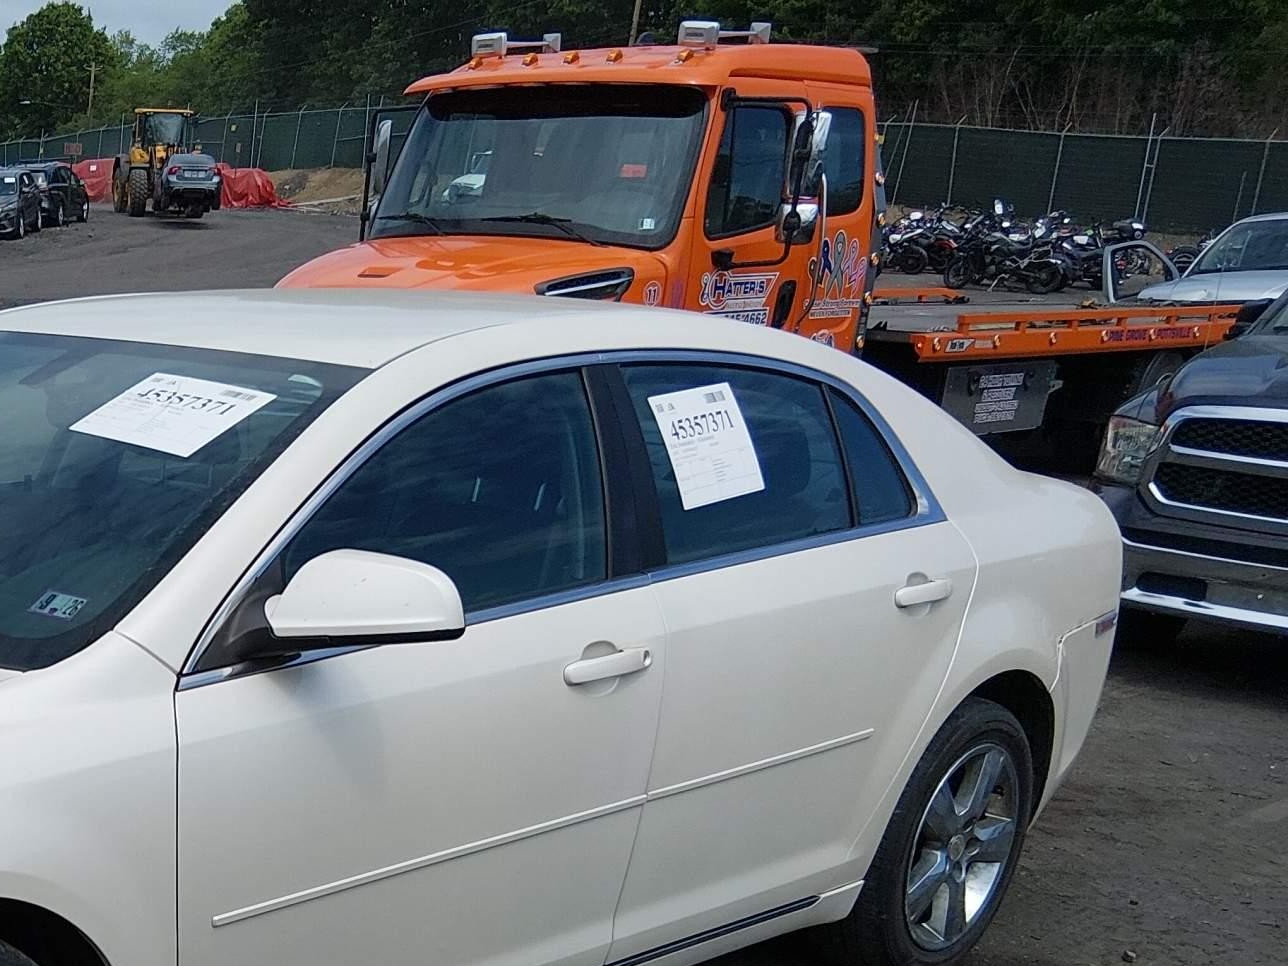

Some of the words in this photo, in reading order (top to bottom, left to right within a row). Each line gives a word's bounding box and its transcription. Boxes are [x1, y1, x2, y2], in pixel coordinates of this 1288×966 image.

[712, 278, 766, 299] HATTER'S
[137, 388, 237, 415] 45357371
[670, 409, 734, 441] 45357371
